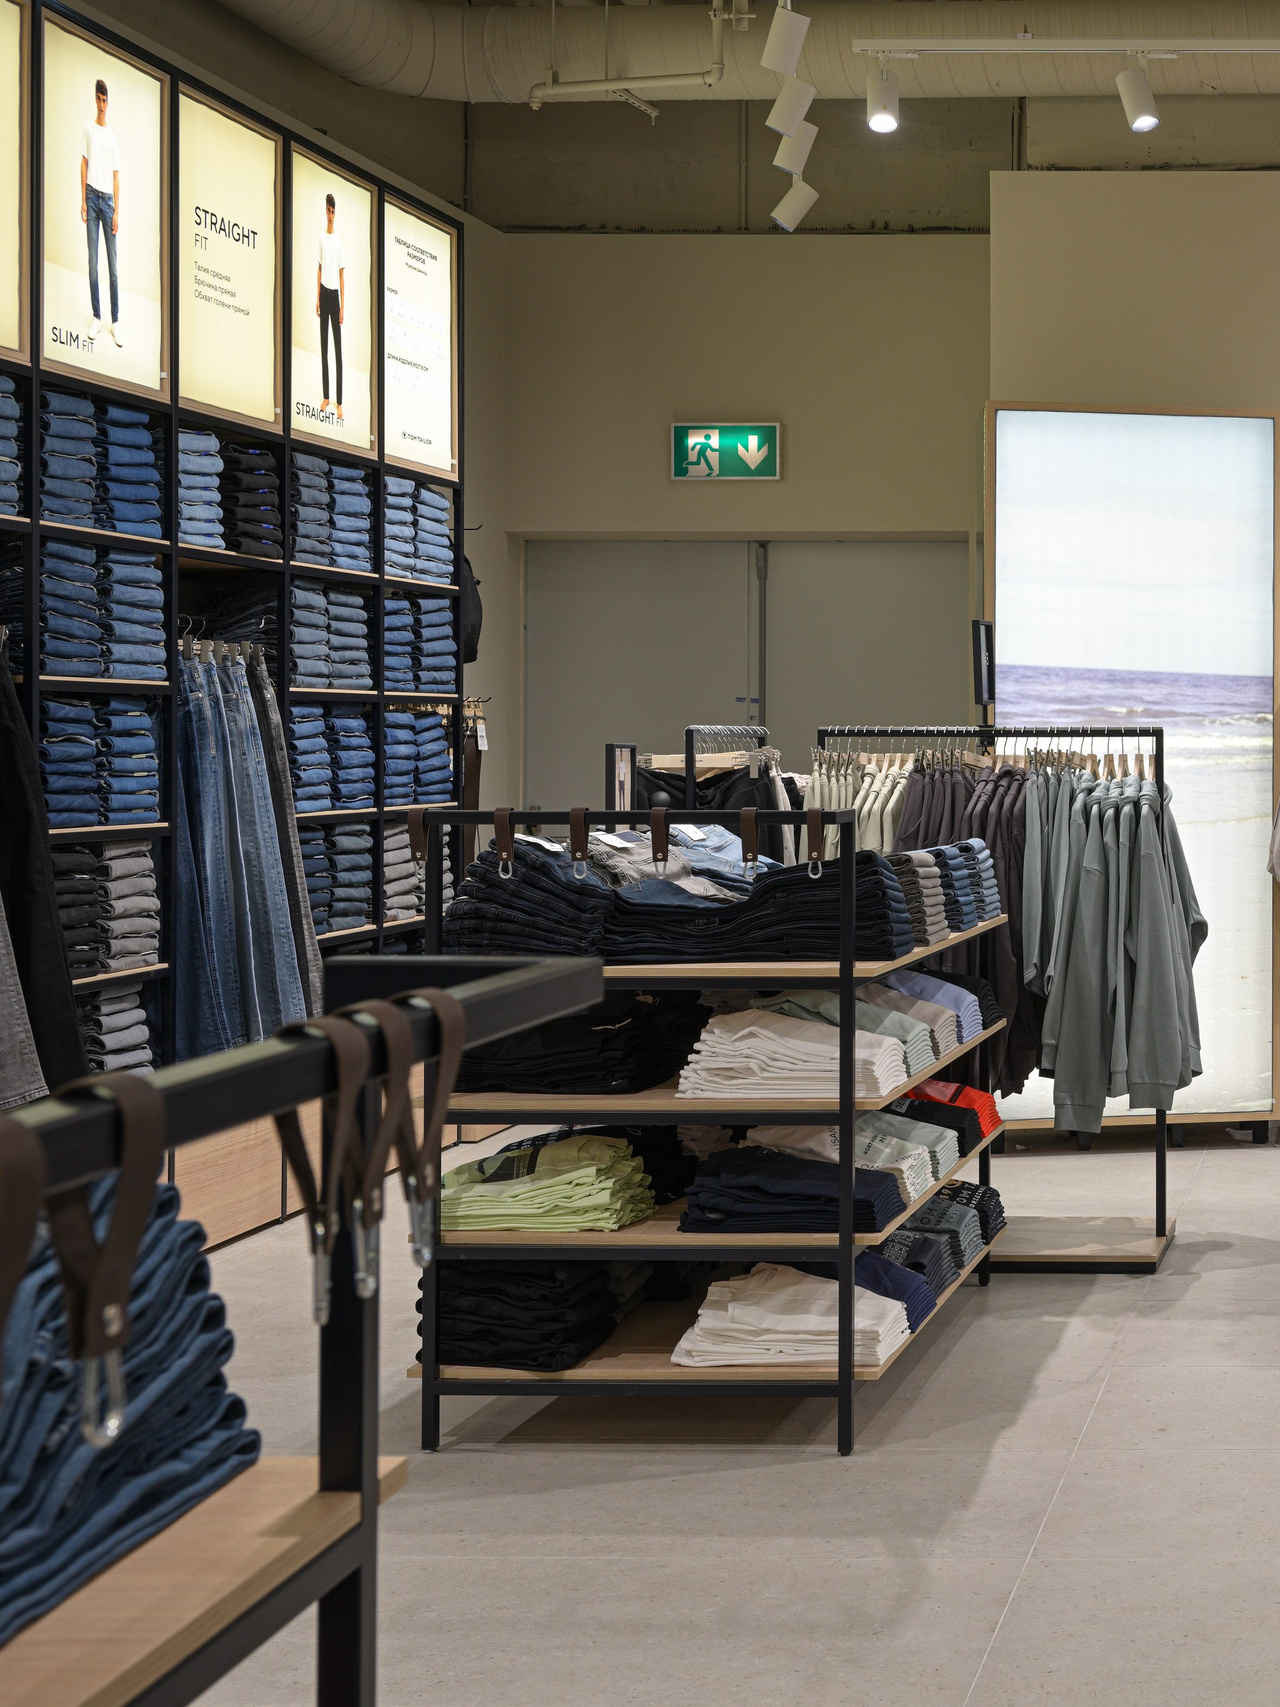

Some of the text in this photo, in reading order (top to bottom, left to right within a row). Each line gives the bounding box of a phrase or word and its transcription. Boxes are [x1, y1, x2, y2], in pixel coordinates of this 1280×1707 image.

[194, 205, 258, 249] STRAIGHT
[194, 233, 209, 251] FIT
[194, 261, 231, 283] Талия средняя
[194, 275, 236, 299] Брючина прямая
[194, 289, 250, 317] Обхват голени прямой
[51, 326, 94, 353] SLIM FIT
[295, 401, 345, 428] STRAIGHT FIT
